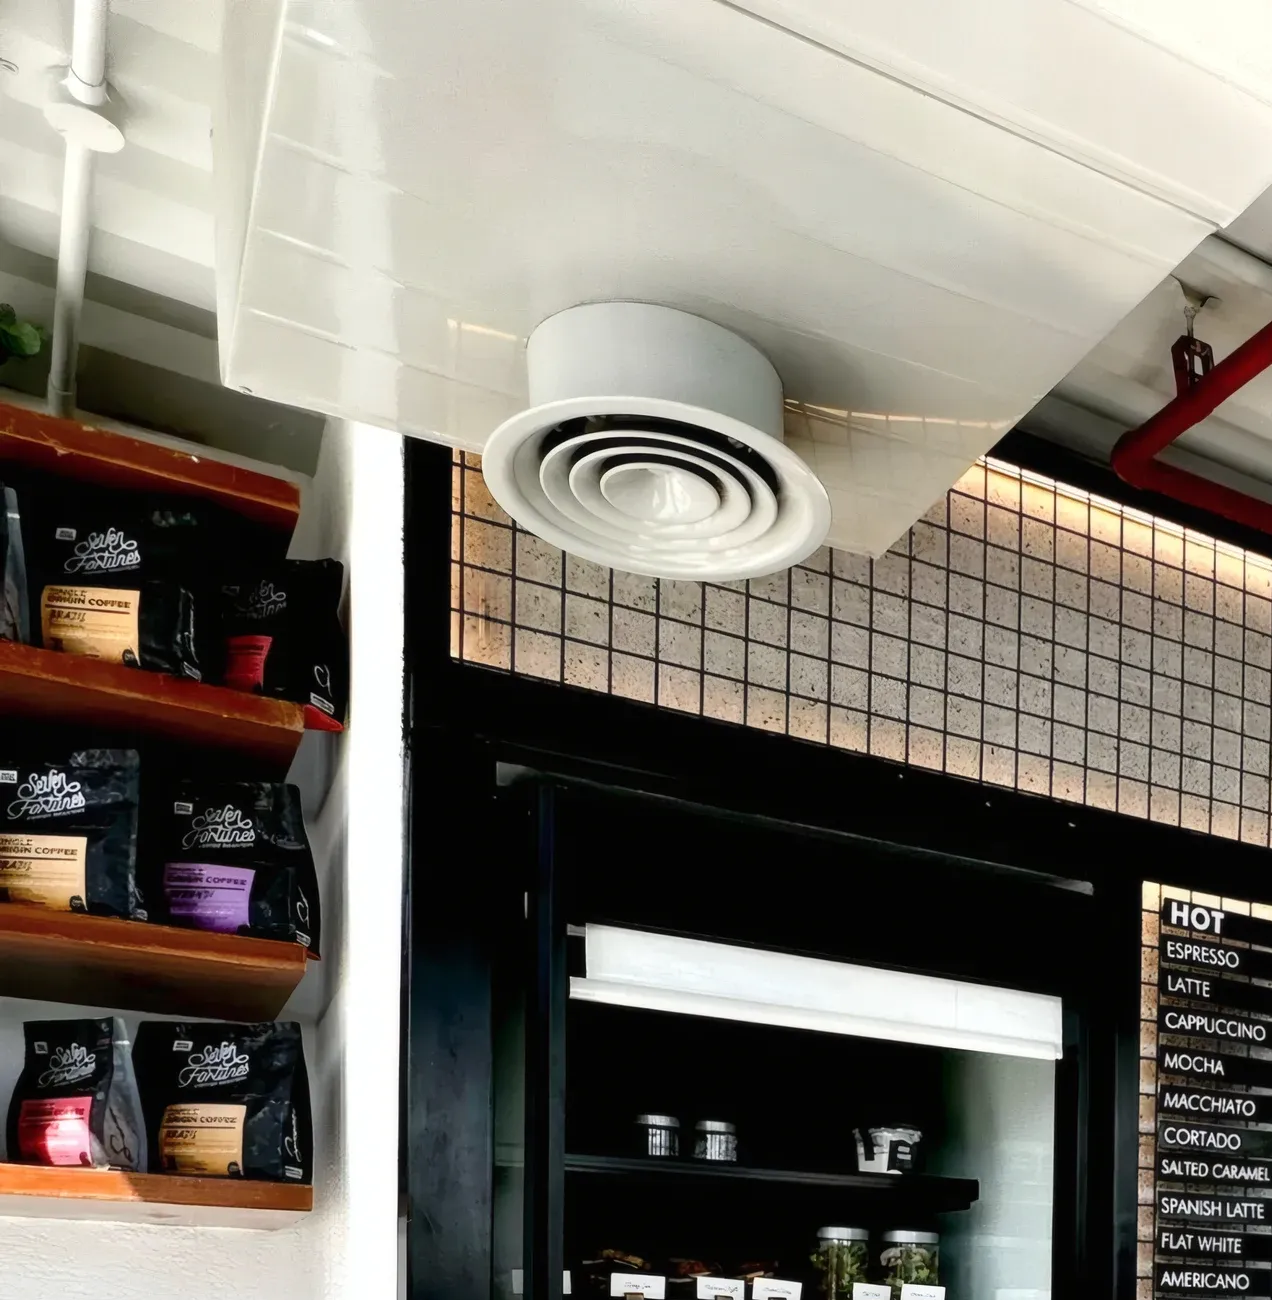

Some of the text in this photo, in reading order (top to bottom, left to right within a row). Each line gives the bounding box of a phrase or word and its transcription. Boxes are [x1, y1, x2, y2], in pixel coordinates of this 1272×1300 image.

[35, 847, 77, 855] COFFEE
[1171, 902, 1224, 934] HOT
[1167, 941, 1240, 968] ESPRESSO
[1167, 976, 1210, 998] LATTE
[1165, 1012, 1266, 1042] CAPPUCCINO
[1165, 1054, 1224, 1076] MOCHA
[1165, 1093, 1256, 1116] MACCHIATO
[1164, 1127, 1241, 1150] CORTADO
[1162, 1159, 1208, 1178] SALTED
[1213, 1164, 1270, 1182] CARAMEL
[1161, 1197, 1222, 1217] SPANISH
[1227, 1202, 1265, 1219] LATTE
[1161, 1233, 1194, 1250] FLAT
[1198, 1235, 1242, 1254] WHITE
[1161, 1271, 1250, 1290] AMERICANO
